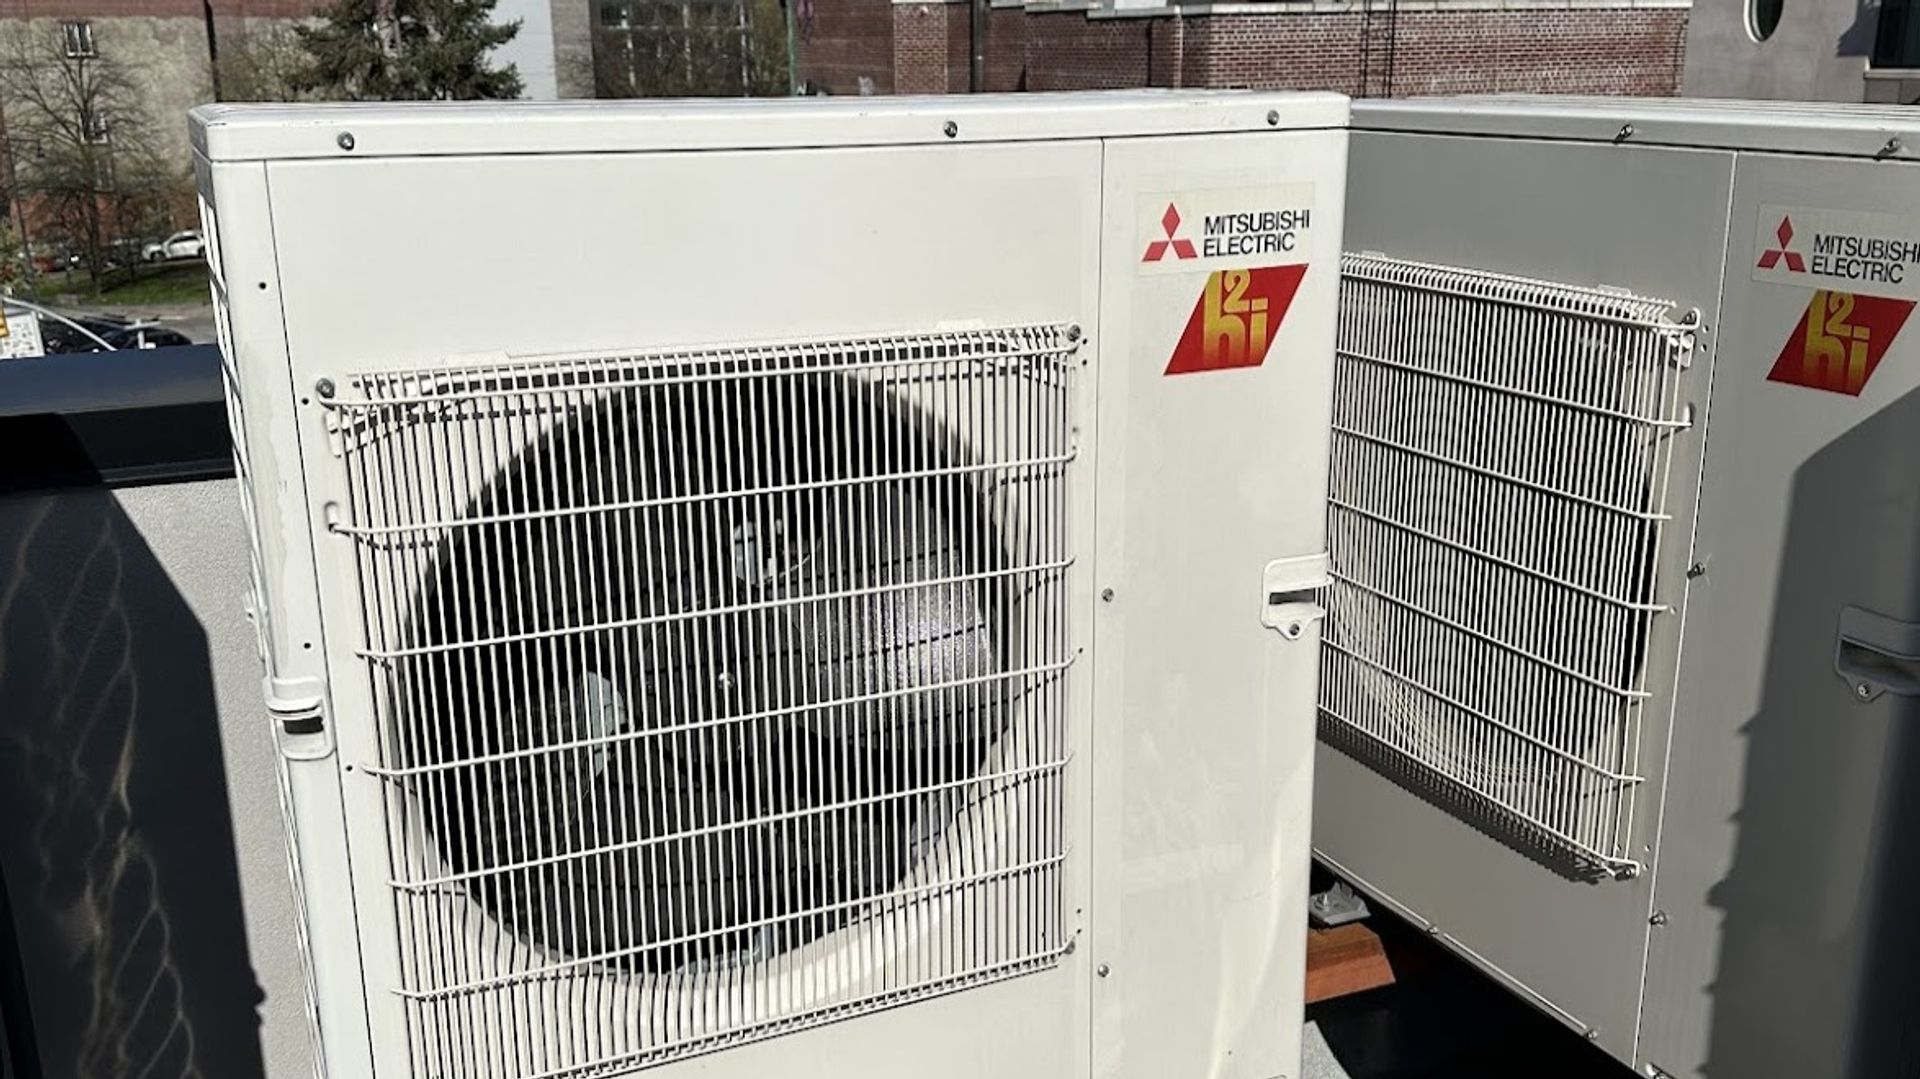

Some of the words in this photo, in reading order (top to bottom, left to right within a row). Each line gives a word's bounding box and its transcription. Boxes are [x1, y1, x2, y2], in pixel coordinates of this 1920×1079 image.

[1204, 210, 1310, 235] MITSUBISHI
[1203, 232, 1295, 257] ELECTRIC
[1811, 255, 1904, 284] ELECTRIC
